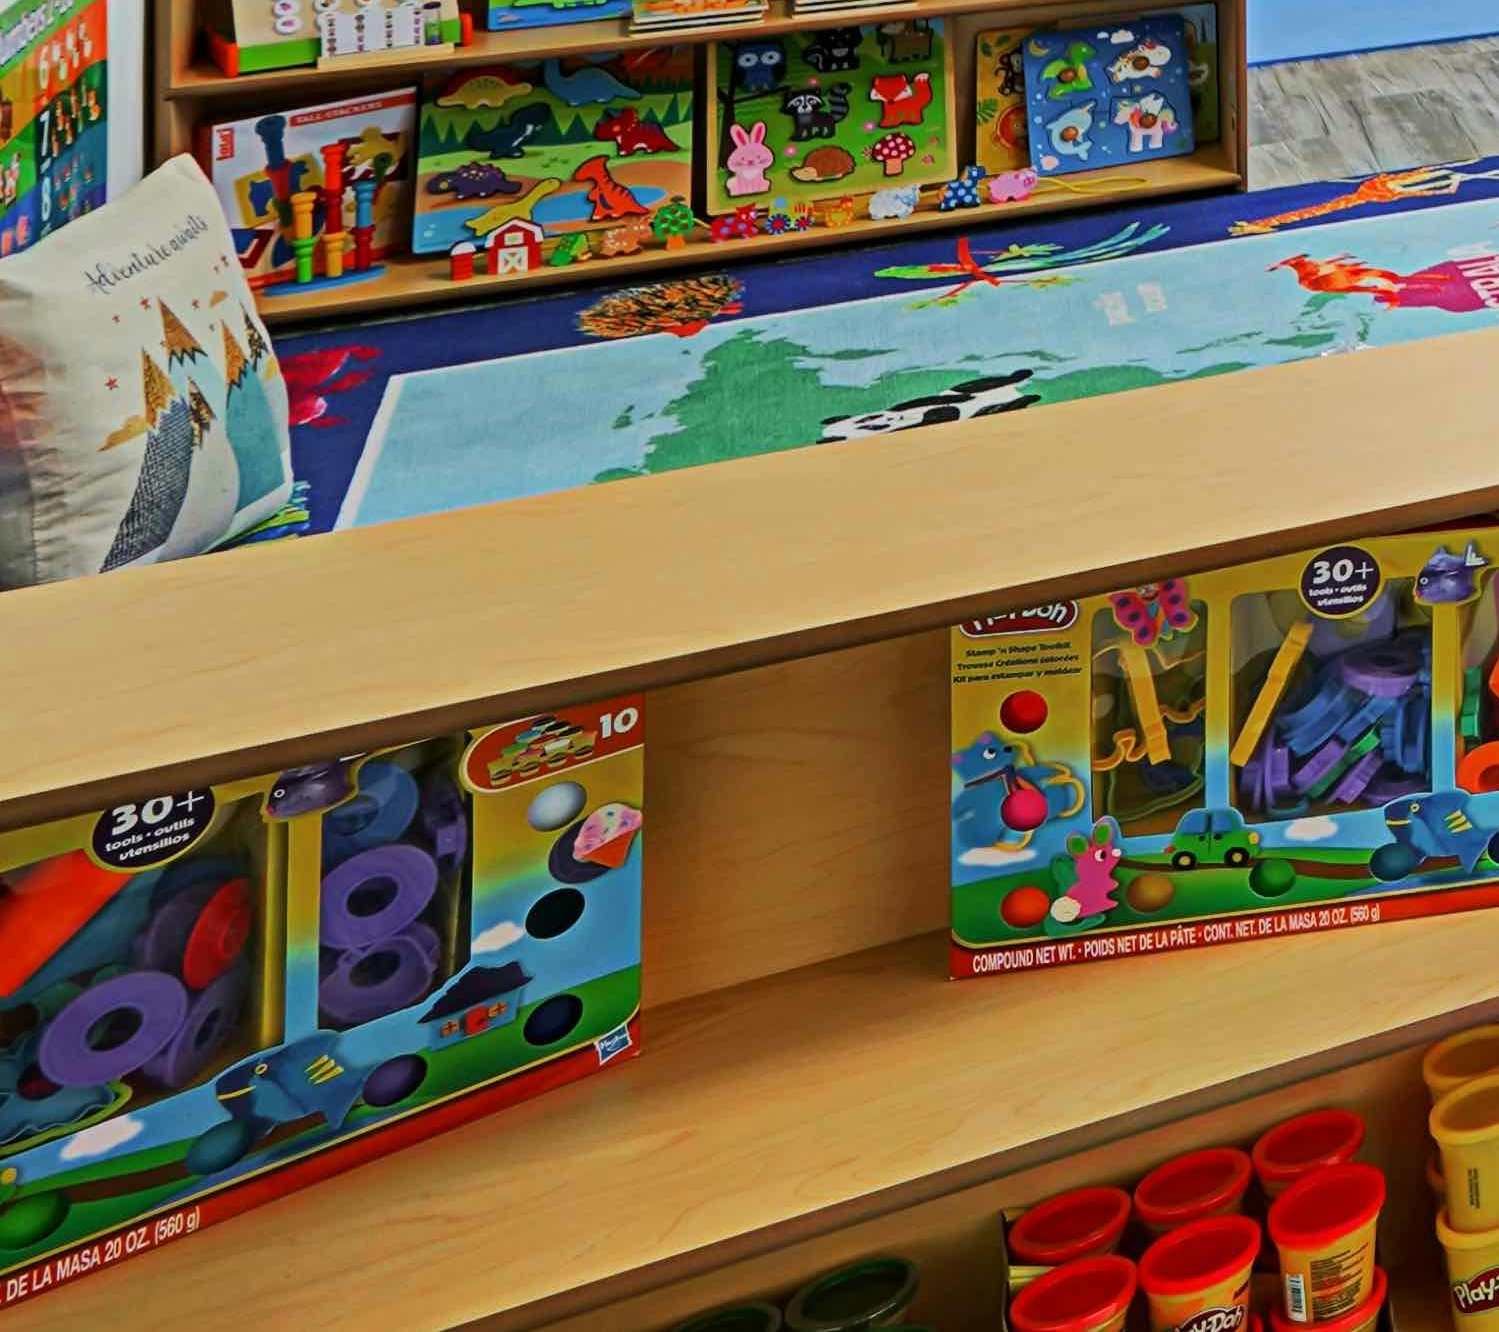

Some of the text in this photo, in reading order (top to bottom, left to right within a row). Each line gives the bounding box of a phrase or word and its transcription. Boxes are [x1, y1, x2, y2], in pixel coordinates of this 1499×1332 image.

[1313, 558, 1374, 584] 30+
[1309, 584, 1367, 597] tools outils
[599, 706, 639, 739] 10
[111, 790, 204, 836] 30+
[105, 817, 195, 852] tools outils
[119, 832, 190, 861] utensilios
[973, 903, 1380, 974] COMPOUND NET WT. POIDS NET DE LA PÂTE CONT. NET. DE LA MASA 20 OZ. (560 g)
[6, 1206, 201, 1302] DE LA MASA 20 OZ. (560 g)
